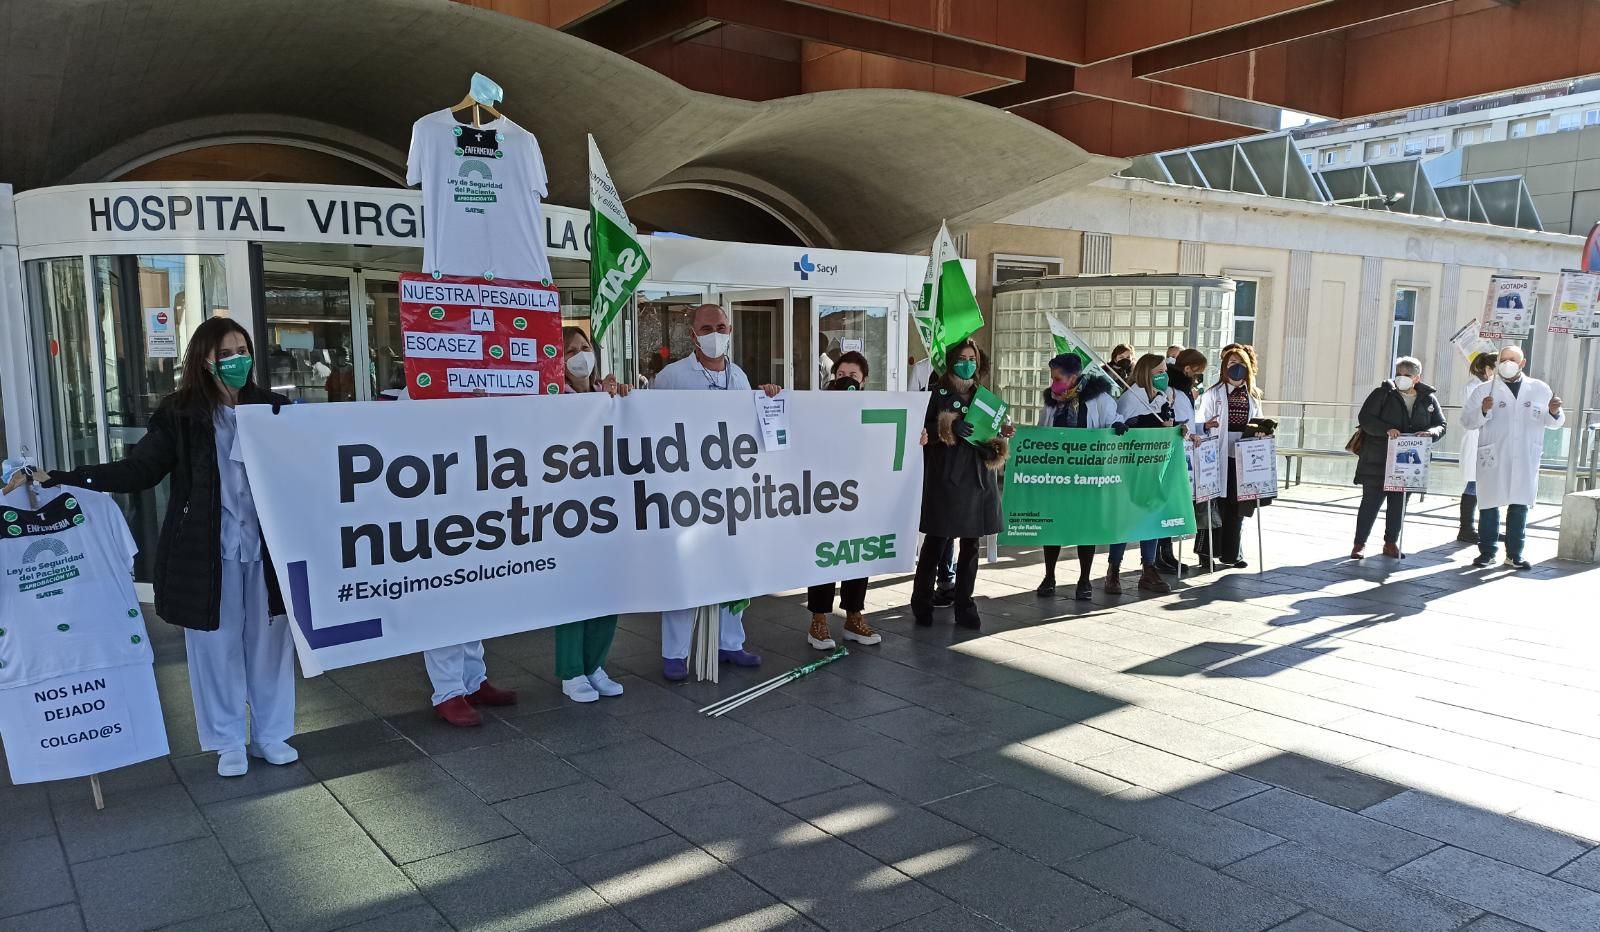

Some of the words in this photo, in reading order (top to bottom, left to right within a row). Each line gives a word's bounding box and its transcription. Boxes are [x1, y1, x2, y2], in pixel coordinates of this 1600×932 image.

[447, 178, 459, 186] Ley
[469, 180, 503, 190] Seguridad
[466, 187, 496, 195] Paciente
[89, 194, 285, 232] HOSPITAL
[306, 198, 424, 238] VIRG
[465, 207, 485, 215] SATSE
[816, 263, 838, 276] Sacyl
[403, 284, 476, 303] NUESTRA
[481, 289, 557, 308] PESADILLA
[472, 311, 491, 326] LA
[406, 335, 477, 353] ESCASEZ
[511, 342, 530, 357] DE
[449, 373, 534, 388] PLANTILLAS
[991, 404, 1007, 430] SATSE
[1016, 438, 1059, 452] ¿Crees
[1061, 442, 1087, 454] que
[1089, 440, 1116, 452] cinco
[1117, 439, 1171, 451] enfermeras
[338, 443, 459, 503] Por
[474, 435, 528, 491] la
[542, 422, 690, 484] salud
[700, 421, 758, 471] de
[1015, 453, 1064, 467] pueden
[1067, 454, 1107, 466] cuidar
[1107, 454, 1118, 464] de
[1119, 453, 1136, 464] mil
[1013, 472, 1071, 484] Nosotros
[1073, 474, 1122, 487] tampoco.
[340, 495, 619, 569] nuestros
[633, 470, 859, 536] hospitales
[1161, 517, 1185, 528] SATSE
[815, 533, 896, 568] SATSE
[6, 567, 24, 576] Ley
[38, 552, 85, 570] Seguridad
[19, 573, 34, 581] del
[36, 565, 76, 578] Paciente
[338, 557, 556, 602] #ExigimosSoluciones
[36, 588, 64, 600] SATSE
[34, 687, 68, 703] NOS
[71, 678, 107, 696] HAN
[44, 699, 106, 722] DEJADO
[40, 723, 122, 749] COLGAD@S
